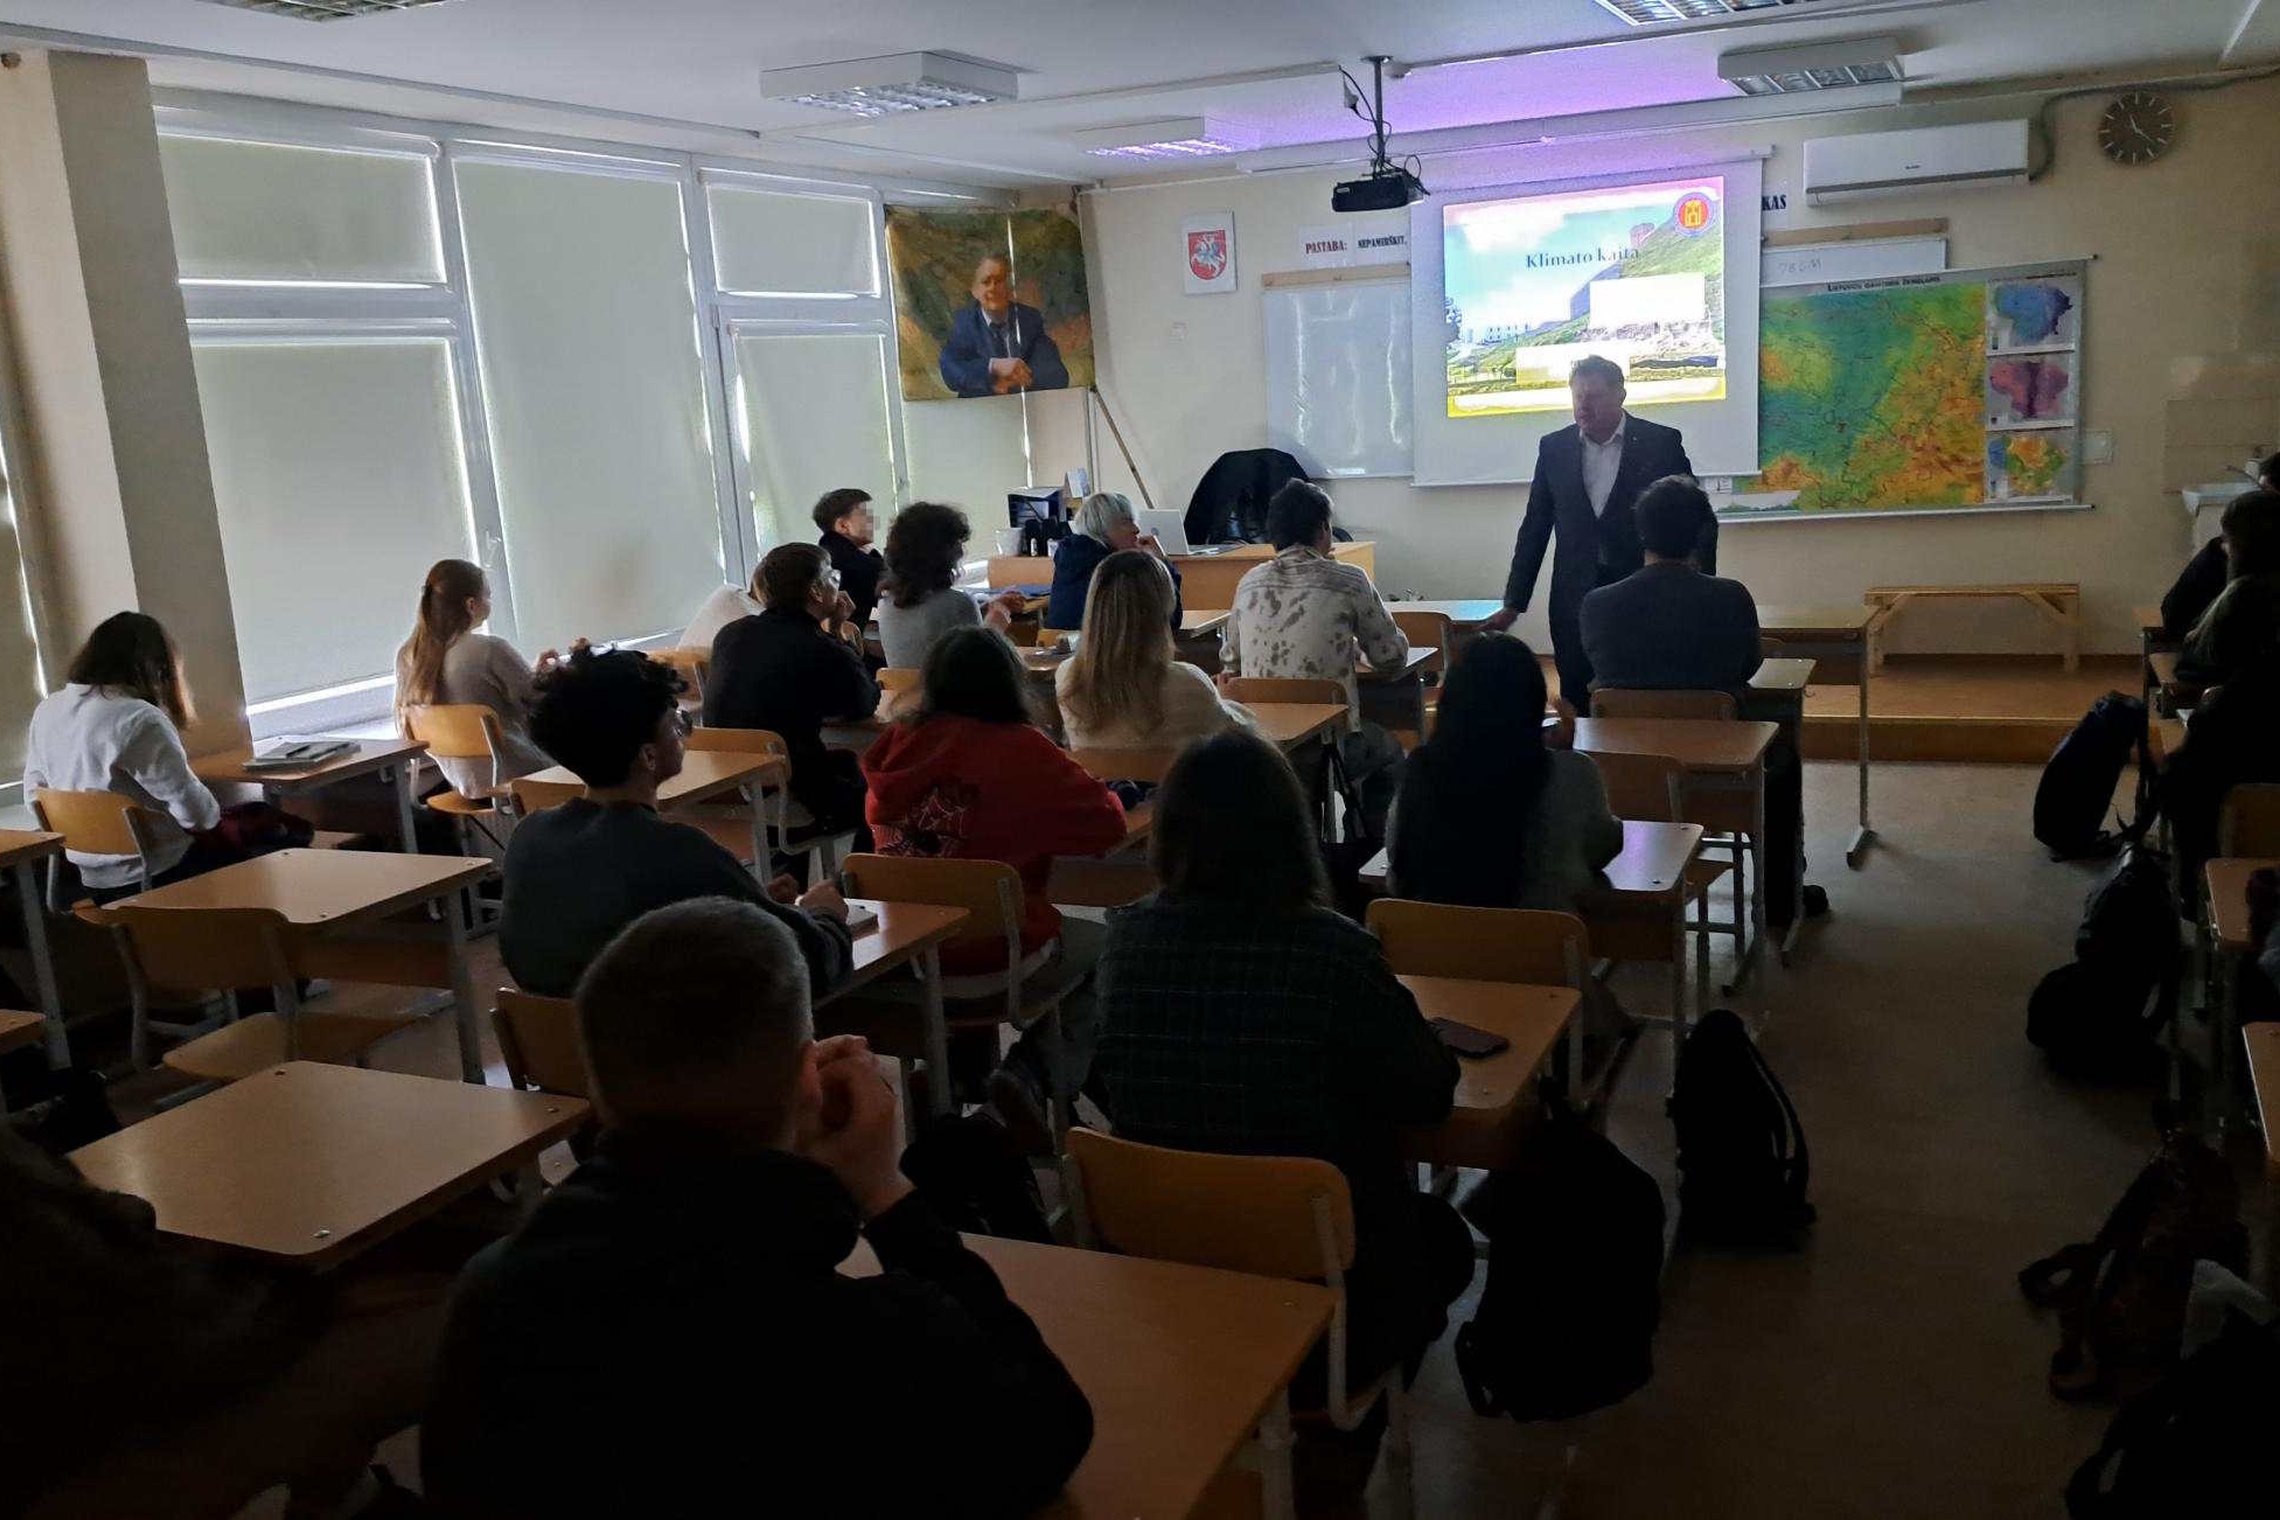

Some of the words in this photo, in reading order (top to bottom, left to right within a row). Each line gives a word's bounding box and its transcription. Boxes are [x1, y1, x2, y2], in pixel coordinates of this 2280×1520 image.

[1305, 240, 1348, 255] PASTABA:
[1526, 252, 1593, 268] Klimato
[1597, 247, 1639, 262] kaita
